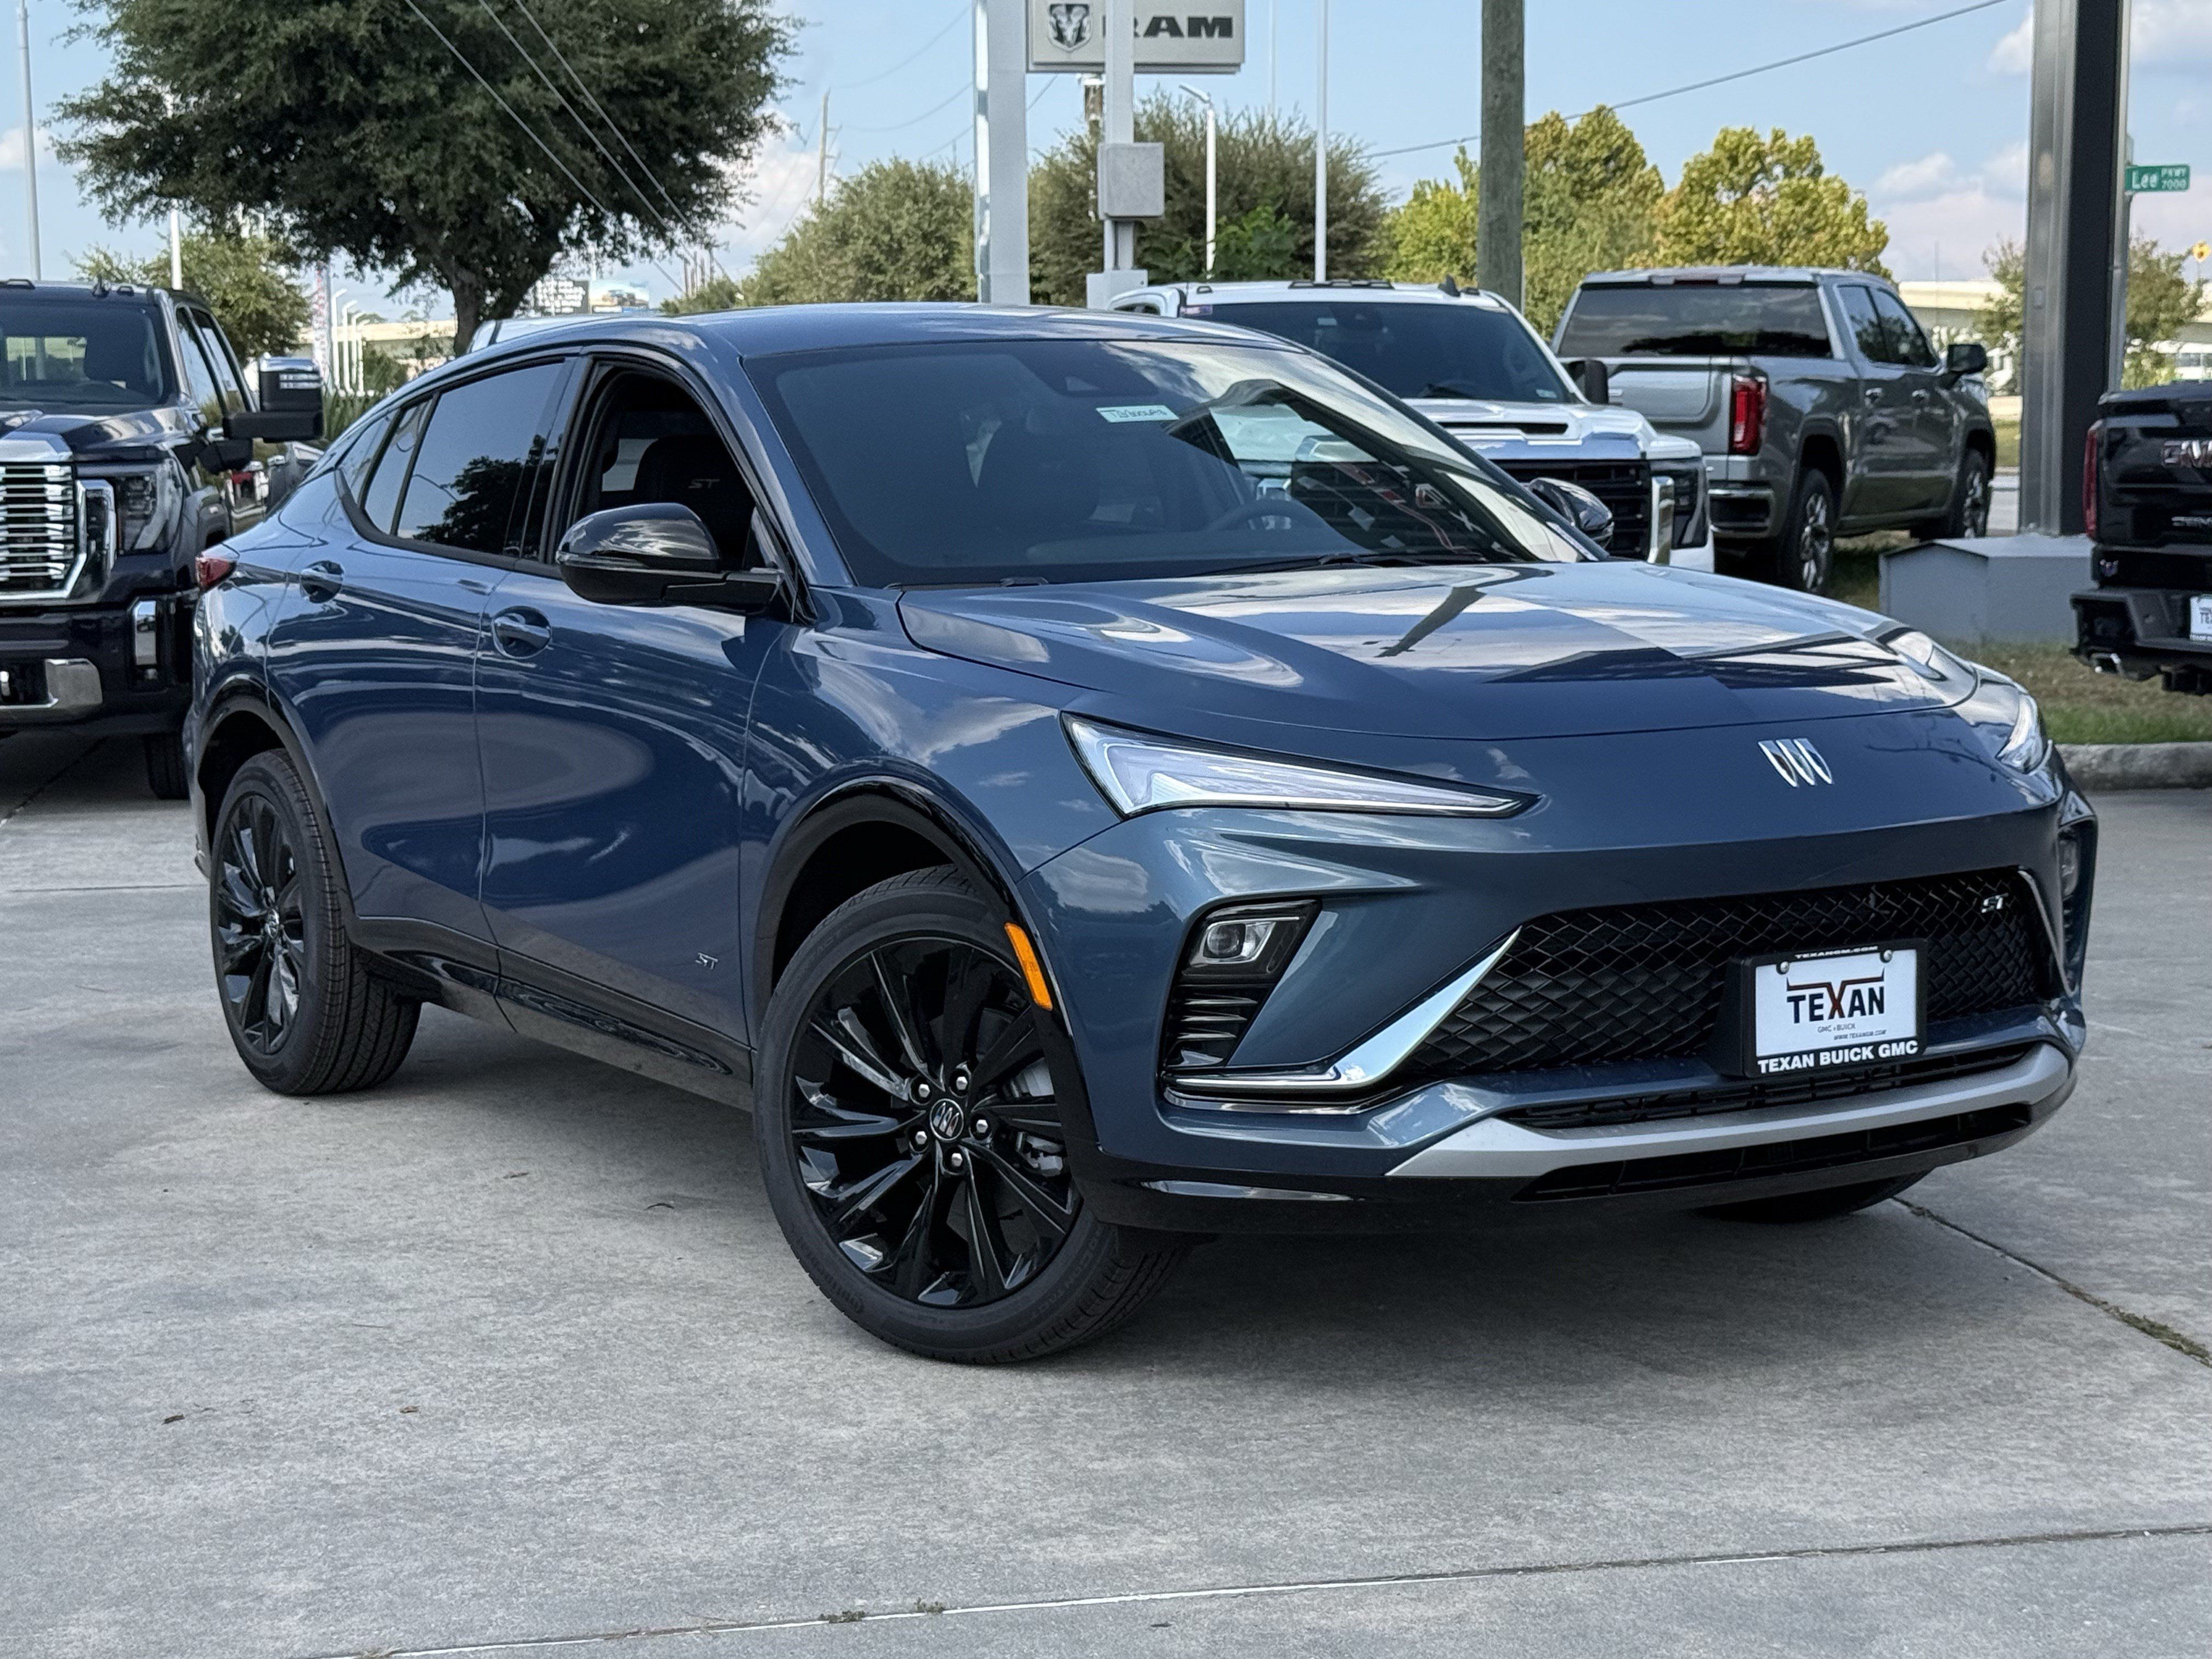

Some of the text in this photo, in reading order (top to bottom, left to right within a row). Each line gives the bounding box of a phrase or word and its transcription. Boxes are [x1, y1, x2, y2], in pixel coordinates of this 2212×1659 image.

[2132, 171, 2158, 189] Lee
[688, 478, 720, 489] ST
[1981, 892, 2009, 913] ST
[695, 952, 719, 969] ST
[1787, 981, 1884, 1024] TEXAN
[1758, 1040, 1918, 1074] TEXAN BUICK GMC
